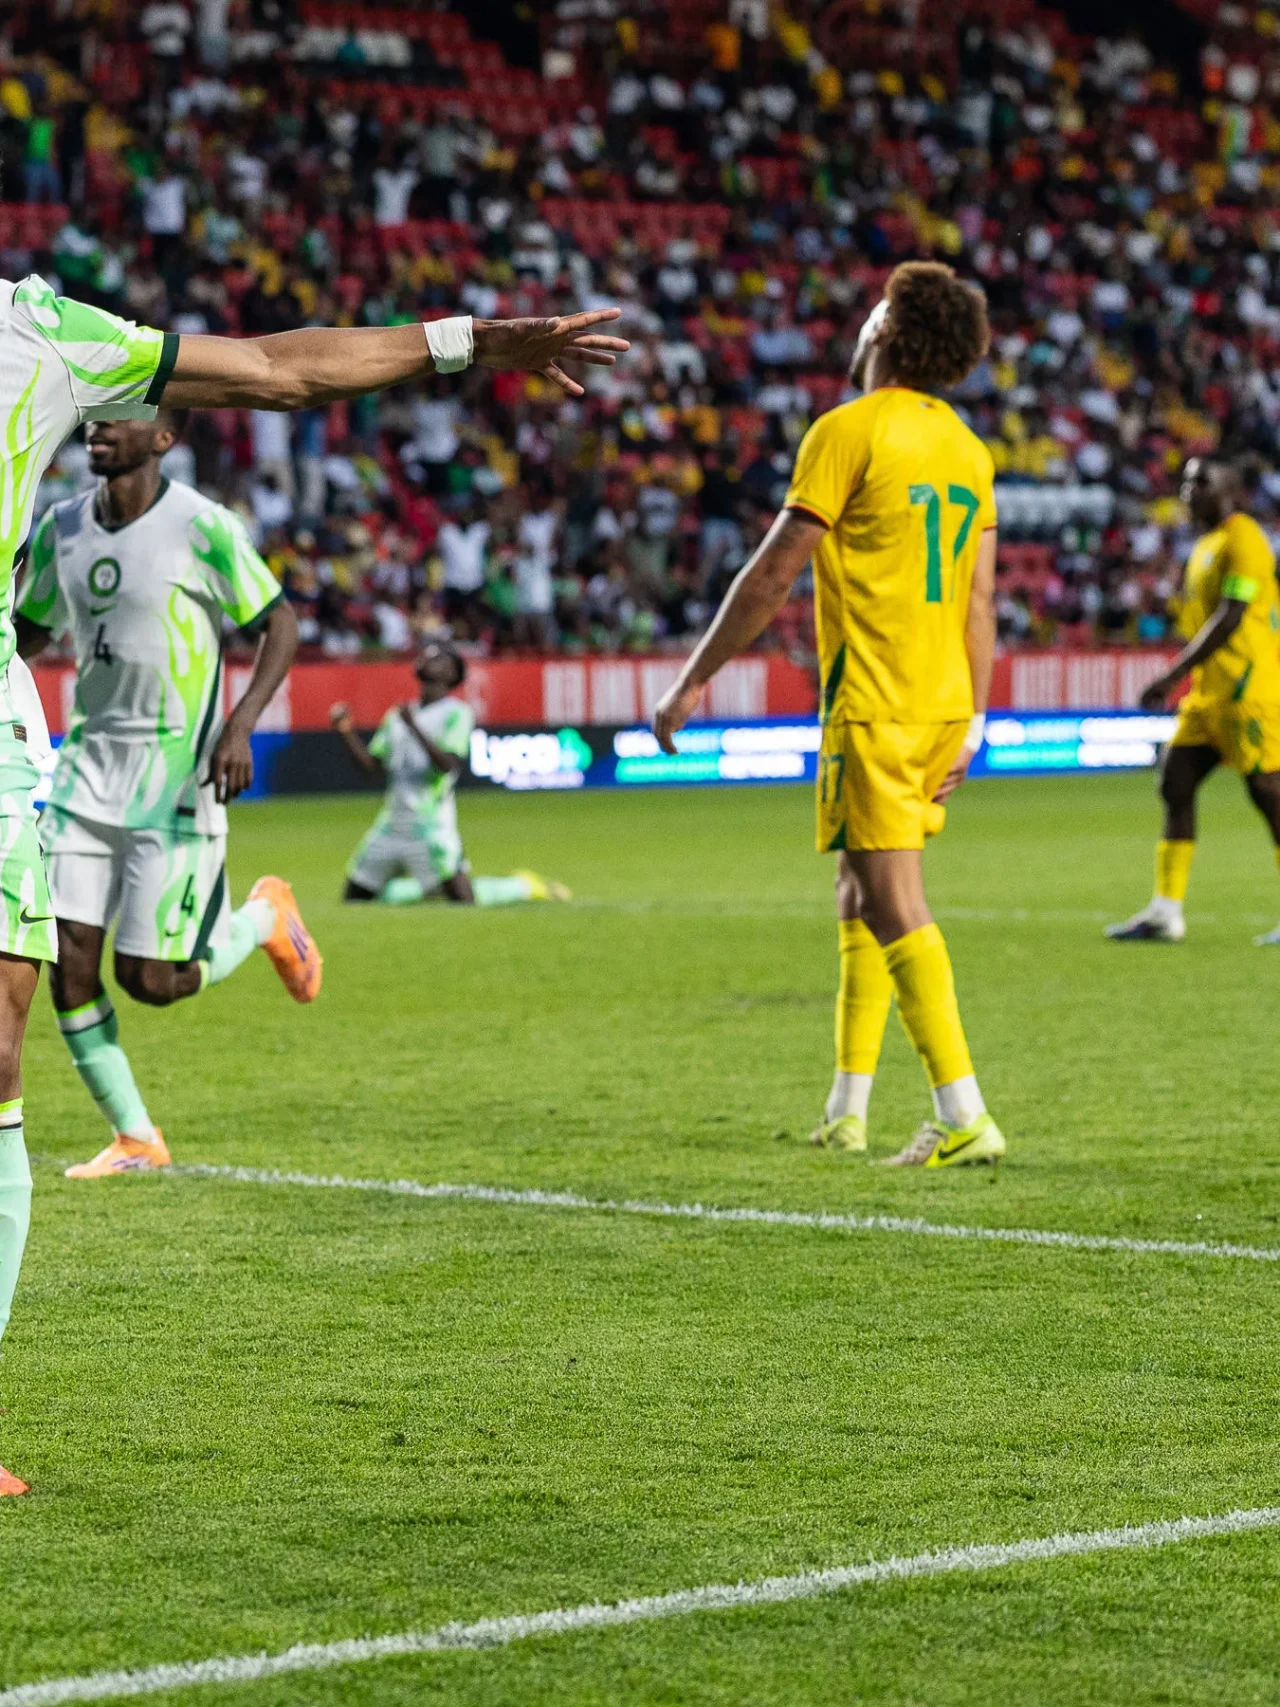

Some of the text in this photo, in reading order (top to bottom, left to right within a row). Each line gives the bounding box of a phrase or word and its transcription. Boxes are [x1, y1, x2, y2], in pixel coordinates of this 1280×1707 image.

[907, 483, 980, 603] 17
[93, 623, 113, 667] 4
[180, 874, 195, 917] 4
